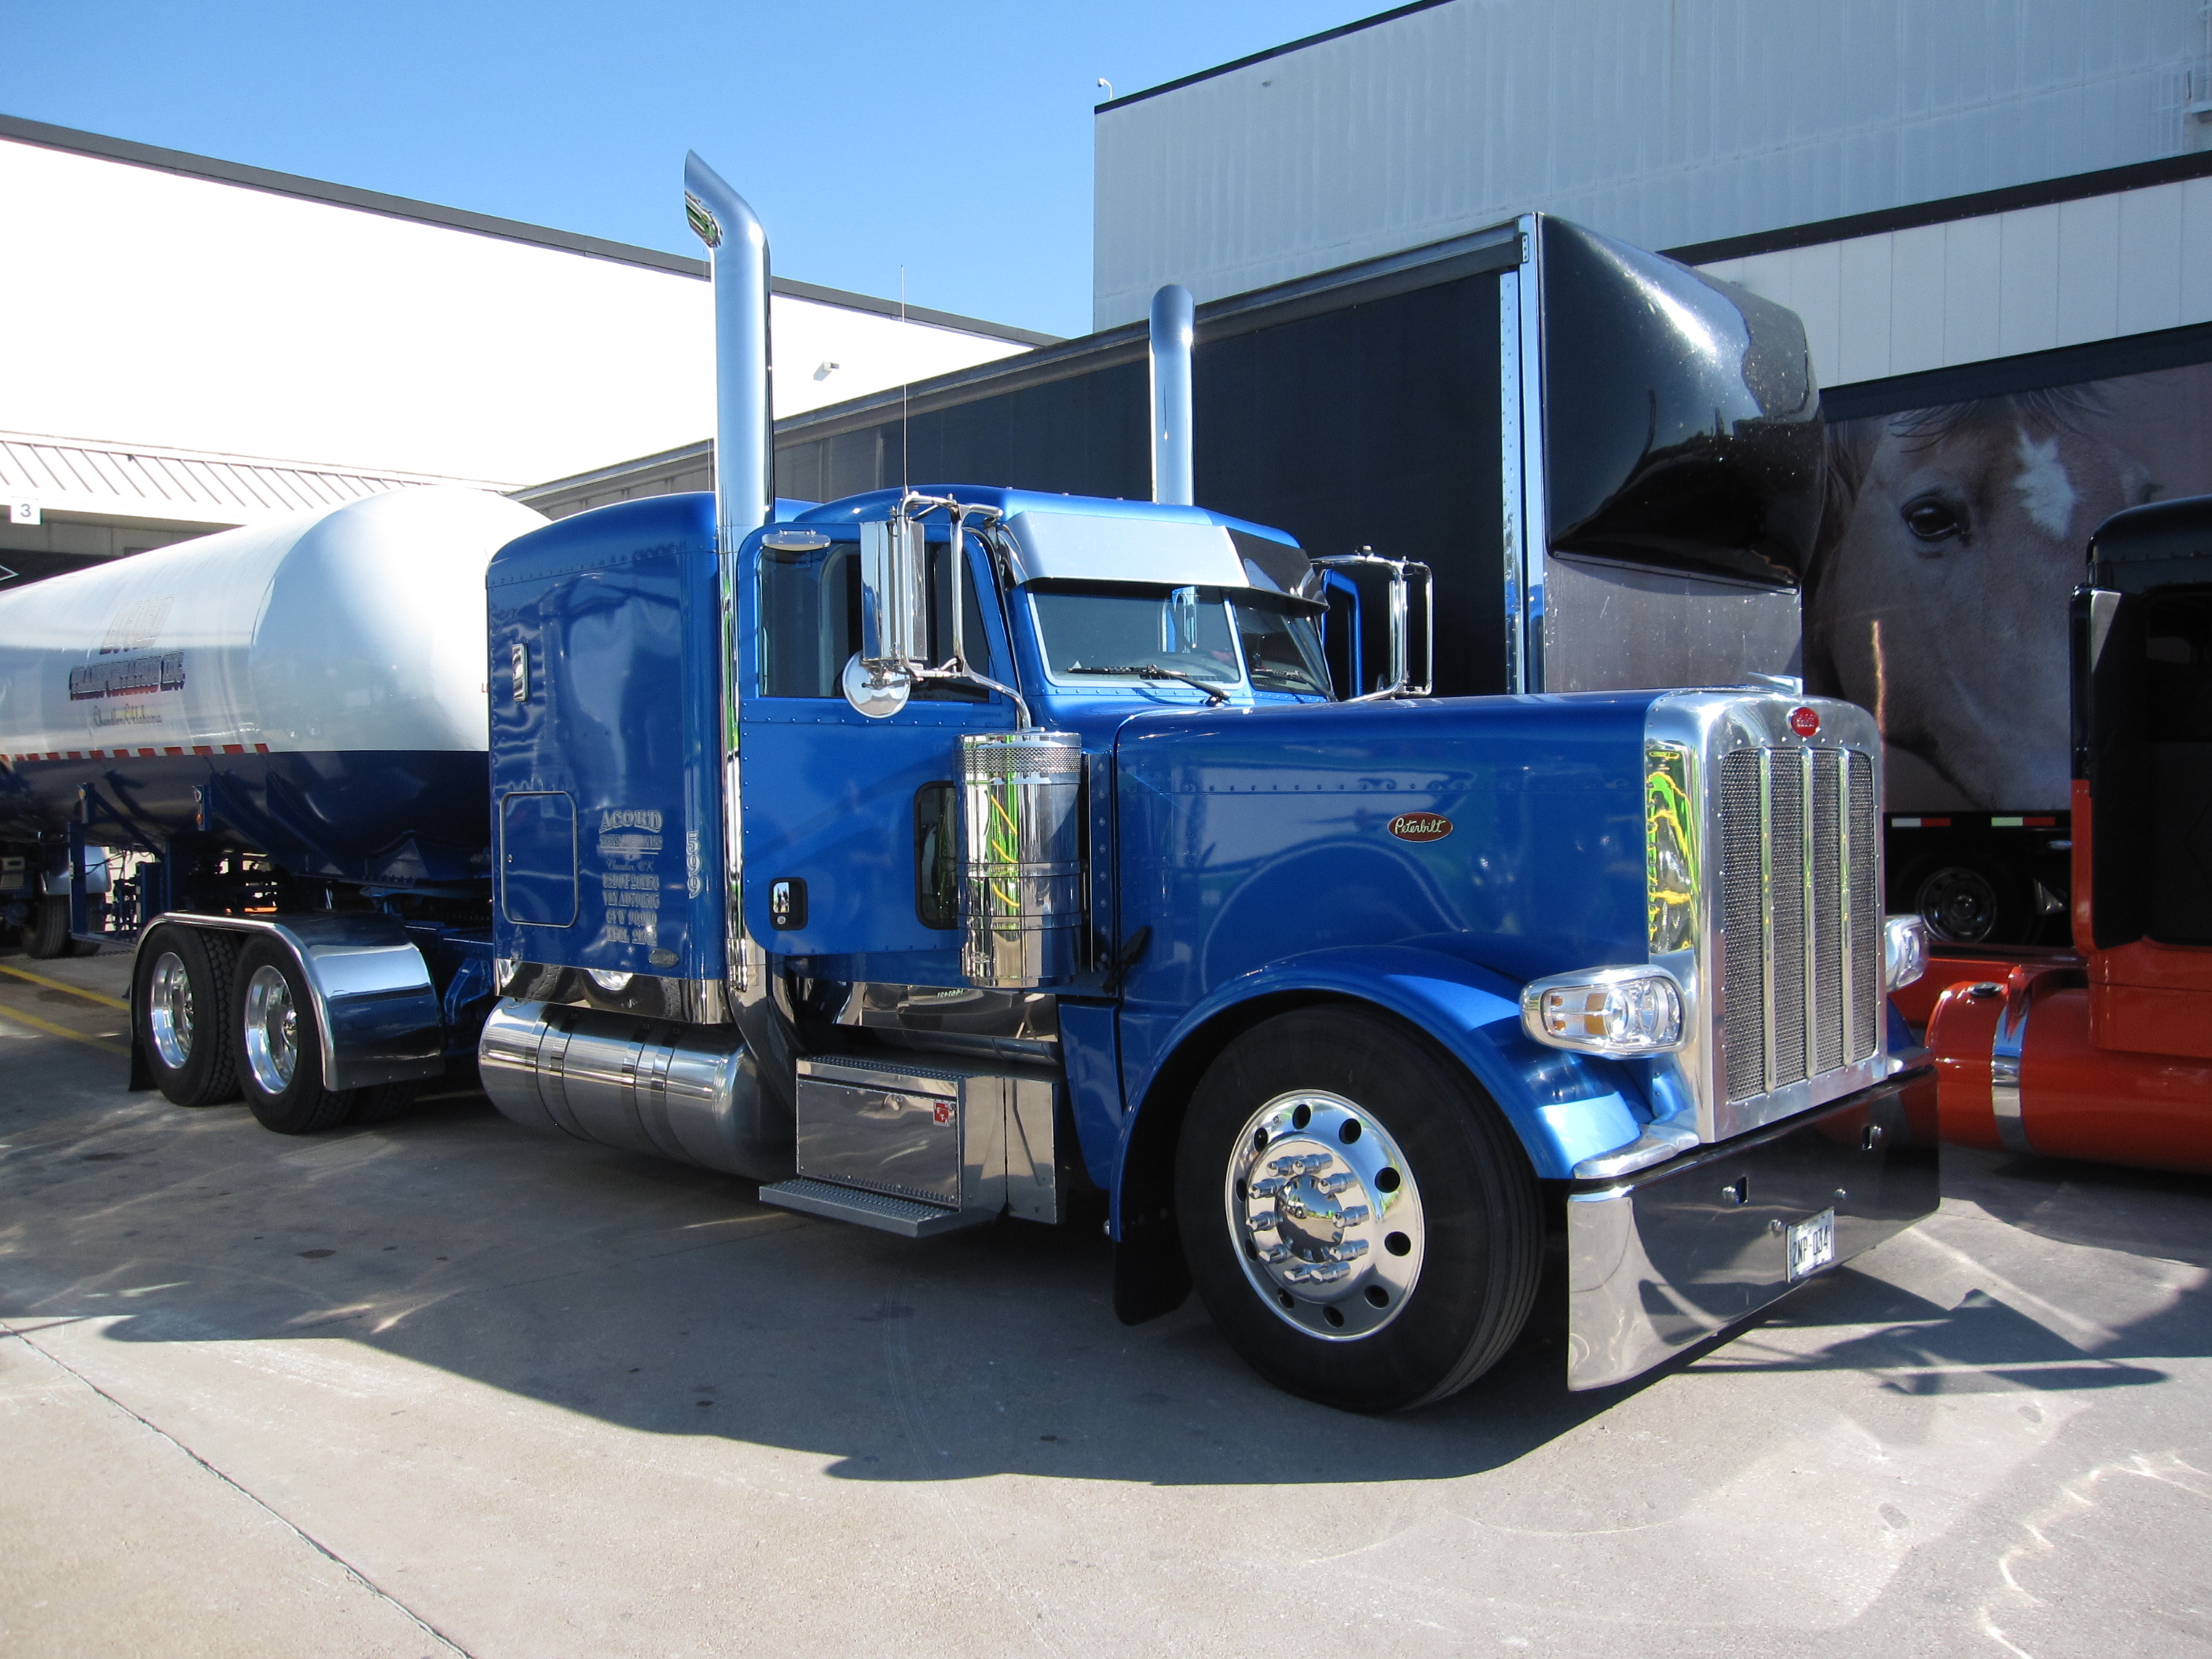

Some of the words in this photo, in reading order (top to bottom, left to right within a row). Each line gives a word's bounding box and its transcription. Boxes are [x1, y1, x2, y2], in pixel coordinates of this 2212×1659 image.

[20, 503, 31, 518] 3
[599, 809, 663, 833] ACORD
[1394, 817, 1447, 834] Peterbilt
[686, 830, 701, 899] 599
